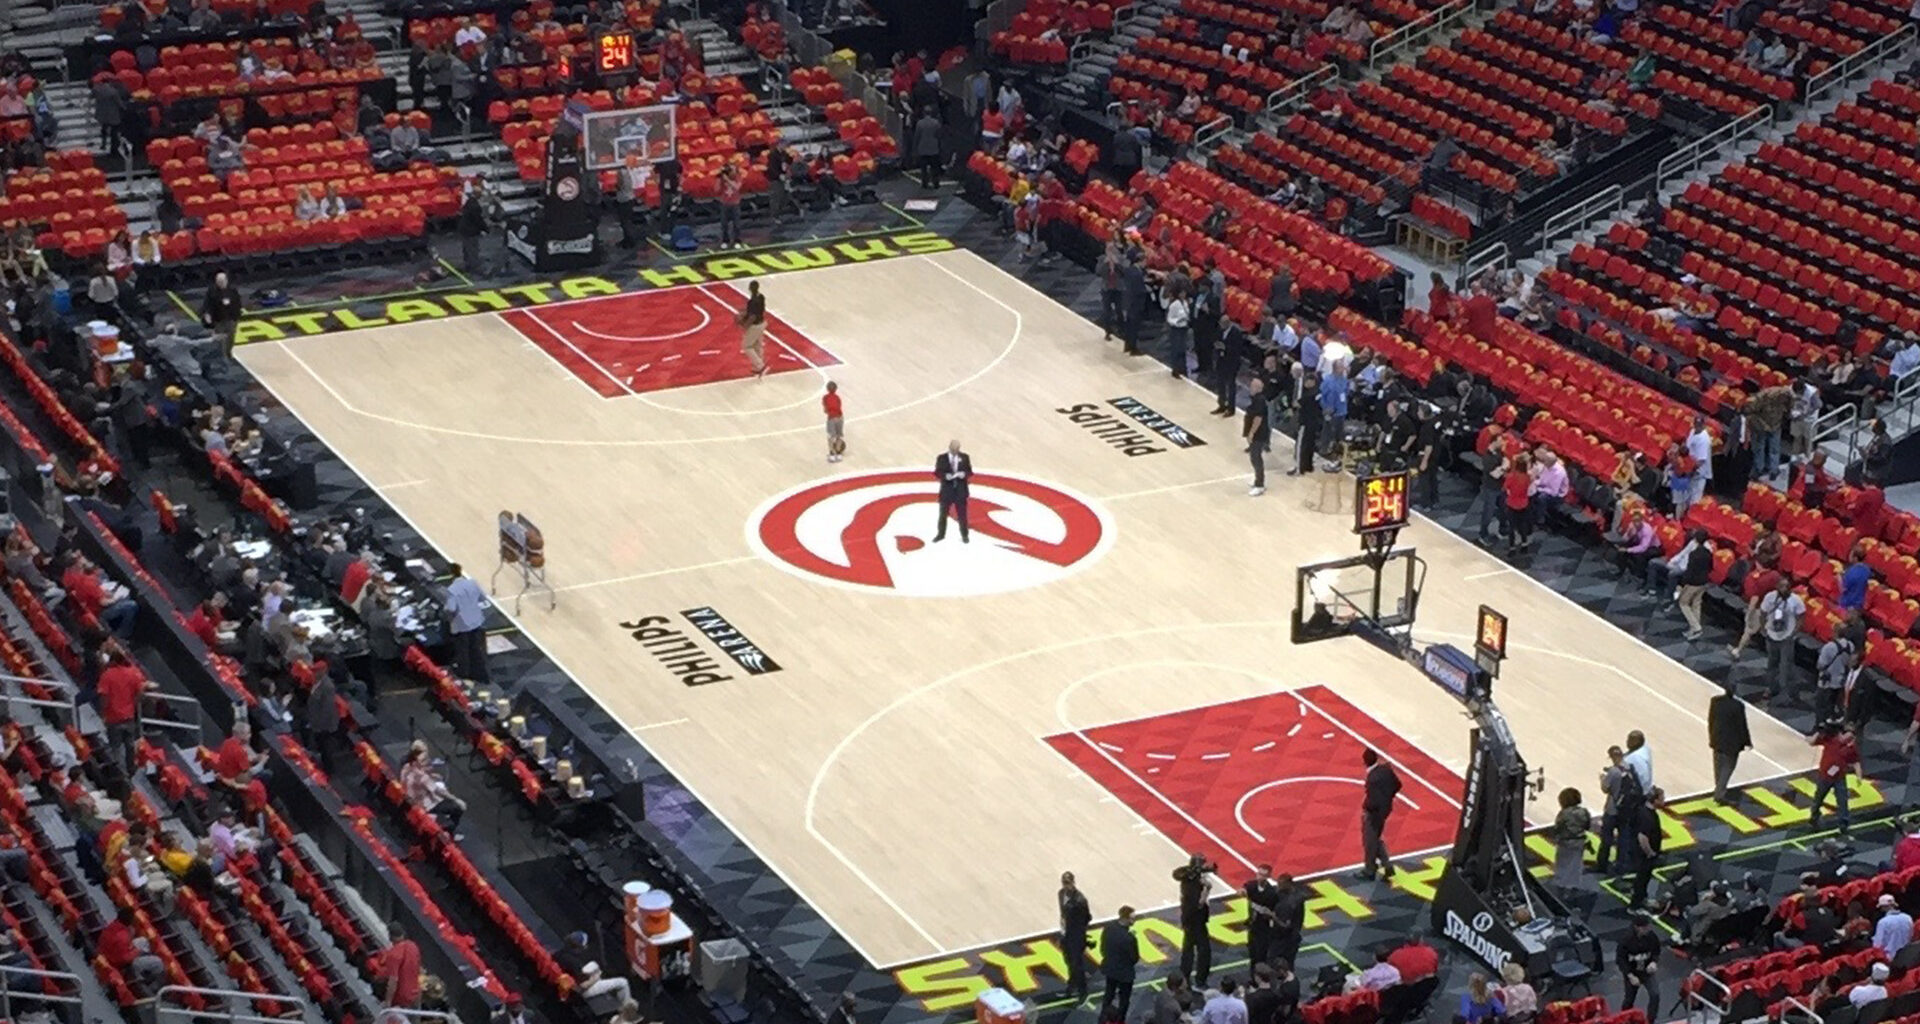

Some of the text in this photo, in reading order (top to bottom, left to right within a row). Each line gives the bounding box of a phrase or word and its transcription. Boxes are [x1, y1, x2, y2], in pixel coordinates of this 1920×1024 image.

[602, 47, 629, 69] 24
[234, 232, 955, 344] ATLANTA HAWKS
[1055, 403, 1168, 457] PHILIPS
[1113, 397, 1181, 434] ARENA
[1367, 495, 1400, 523] 24
[619, 616, 734, 688] PHILIPS
[686, 608, 760, 656] ARENA
[1443, 910, 1513, 978] SPALDING
